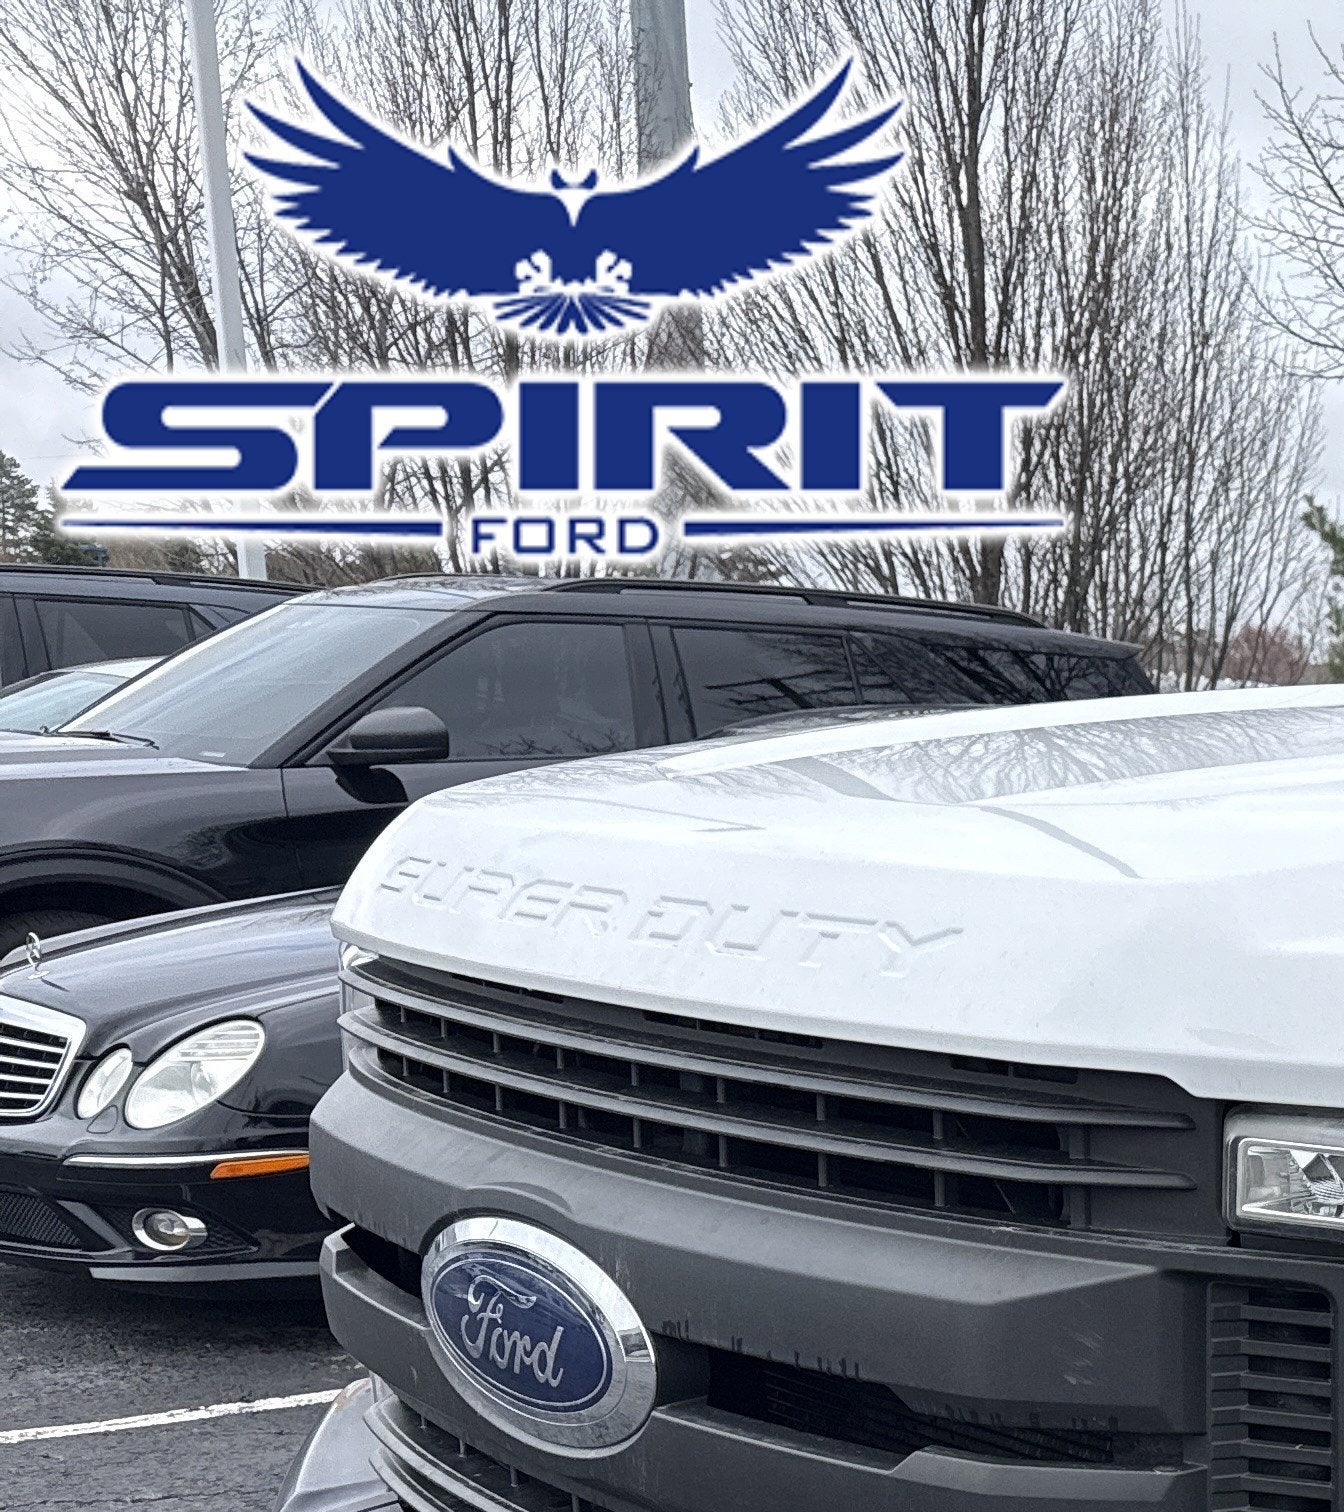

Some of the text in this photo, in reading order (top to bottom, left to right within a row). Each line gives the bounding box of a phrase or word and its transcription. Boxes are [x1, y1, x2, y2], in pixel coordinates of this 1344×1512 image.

[377, 856, 965, 978] SUPER DUTY
[460, 1274, 564, 1388] Ford
